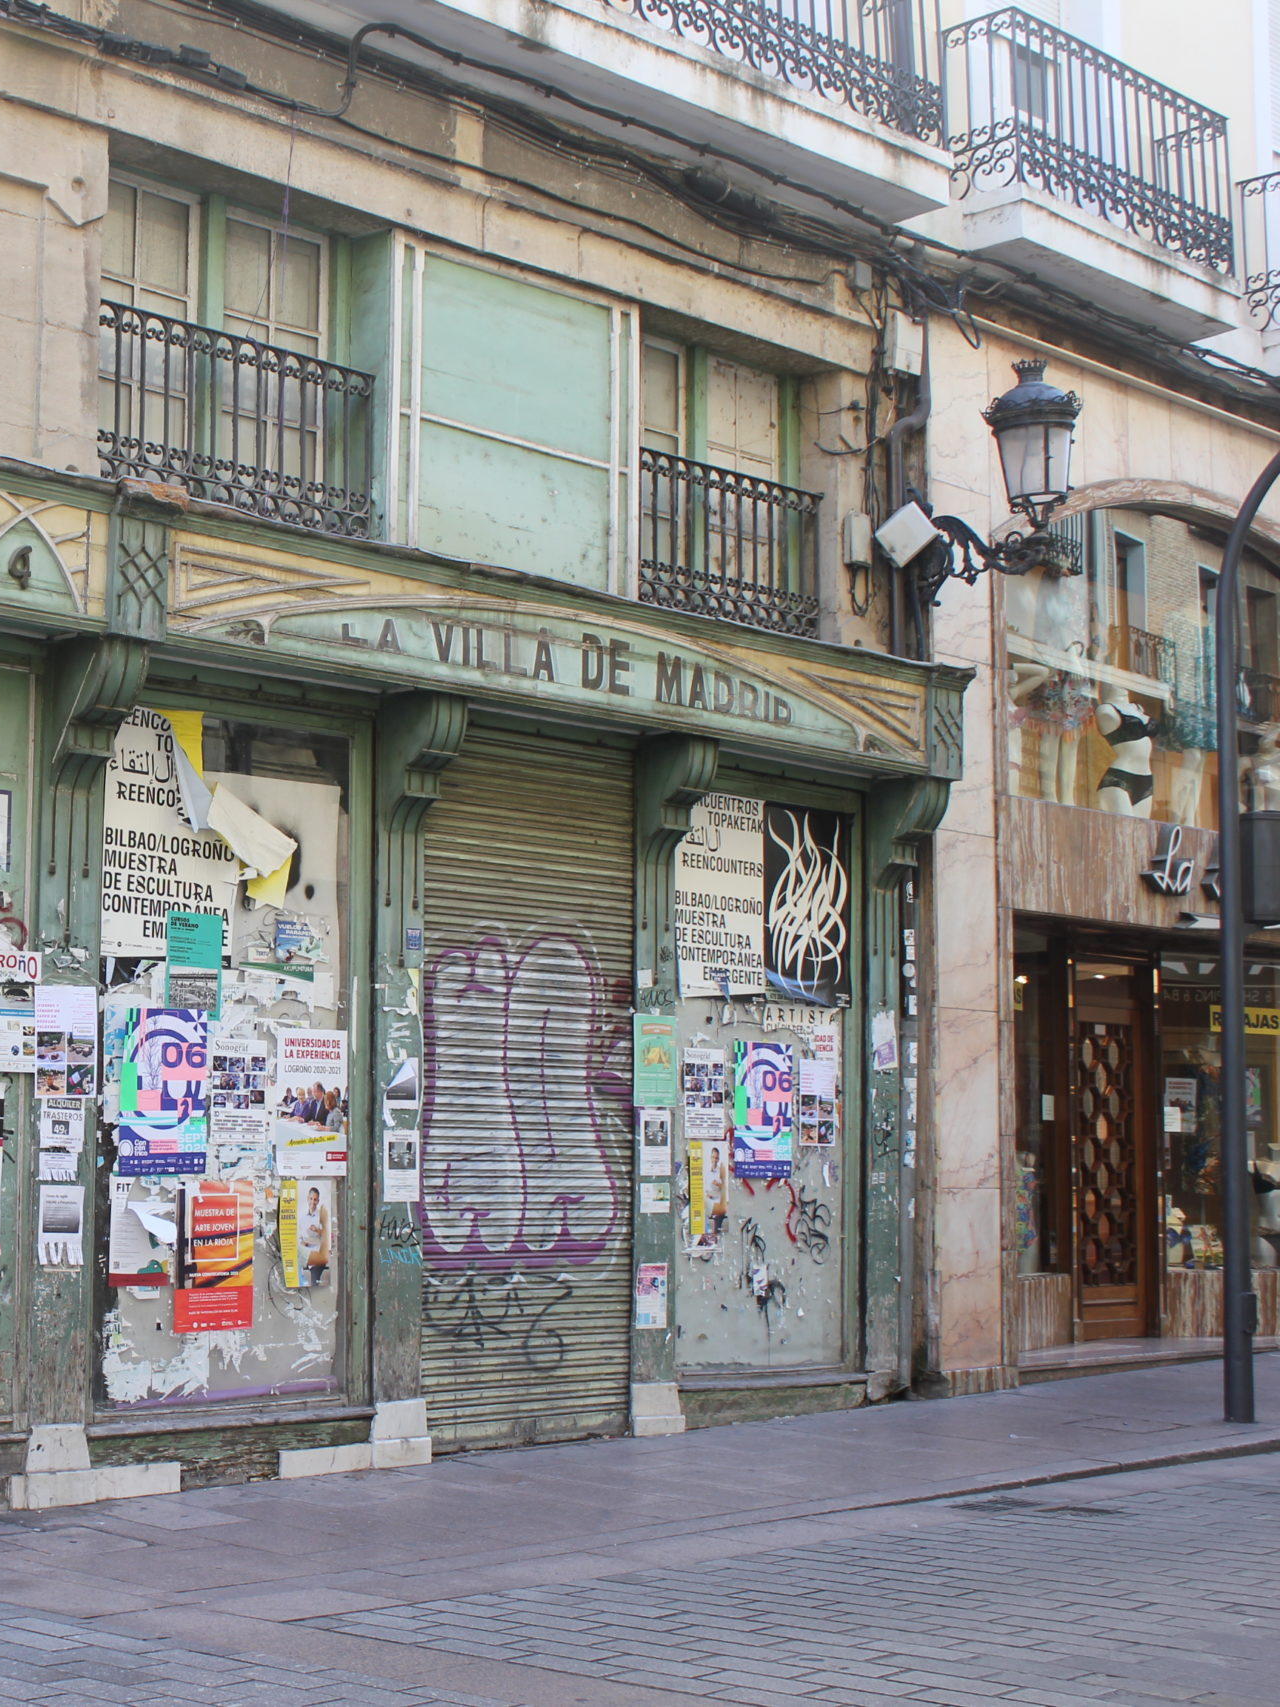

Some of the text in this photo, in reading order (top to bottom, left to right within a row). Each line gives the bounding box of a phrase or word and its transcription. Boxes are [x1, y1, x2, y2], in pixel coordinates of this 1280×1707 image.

[341, 618, 793, 727] LA VILLA DE MADRID
[103, 849, 178, 877] MUESTRA
[682, 850, 763, 878] REENCOUNTERS
[103, 870, 214, 903] DE ESCULTURA
[674, 889, 763, 916] BILBAO/LOGROÑO
[674, 908, 726, 930] MUESTRA
[674, 926, 752, 950] DE ESCULTURA
[1211, 1011, 1280, 1030] RAJAS
[284, 1037, 341, 1049] UNIVERSIDAD DE
[161, 1041, 209, 1069] 06
[284, 1049, 342, 1060] LA EXPERIENCIA
[284, 1063, 341, 1075] LOGROÑO 2020-2021
[762, 1070, 793, 1093] 06
[47, 1099, 82, 1109] ALQUILER
[43, 1110, 83, 1121] TRASTEROS
[194, 1207, 235, 1217] MUESTRA DE
[194, 1222, 235, 1232] ARTE JOVEN
[193, 1237, 234, 1247] EN LA RIOJA
